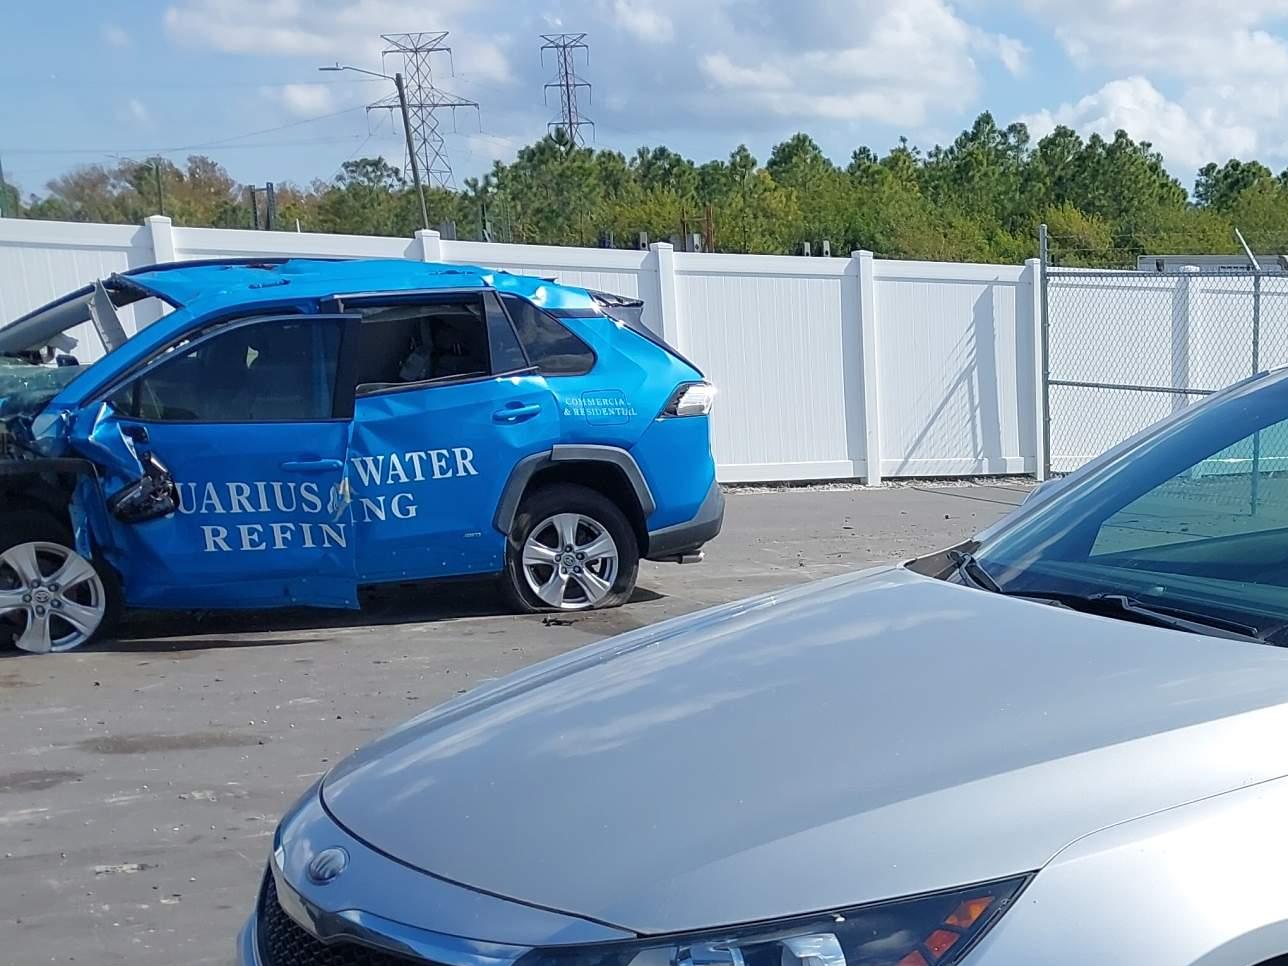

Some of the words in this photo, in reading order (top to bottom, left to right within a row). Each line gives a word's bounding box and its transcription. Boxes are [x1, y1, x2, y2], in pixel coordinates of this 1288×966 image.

[563, 407, 571, 416] &
[176, 481, 322, 514] UARIUS
[350, 446, 479, 487] WATER
[201, 522, 348, 552] REFIN
